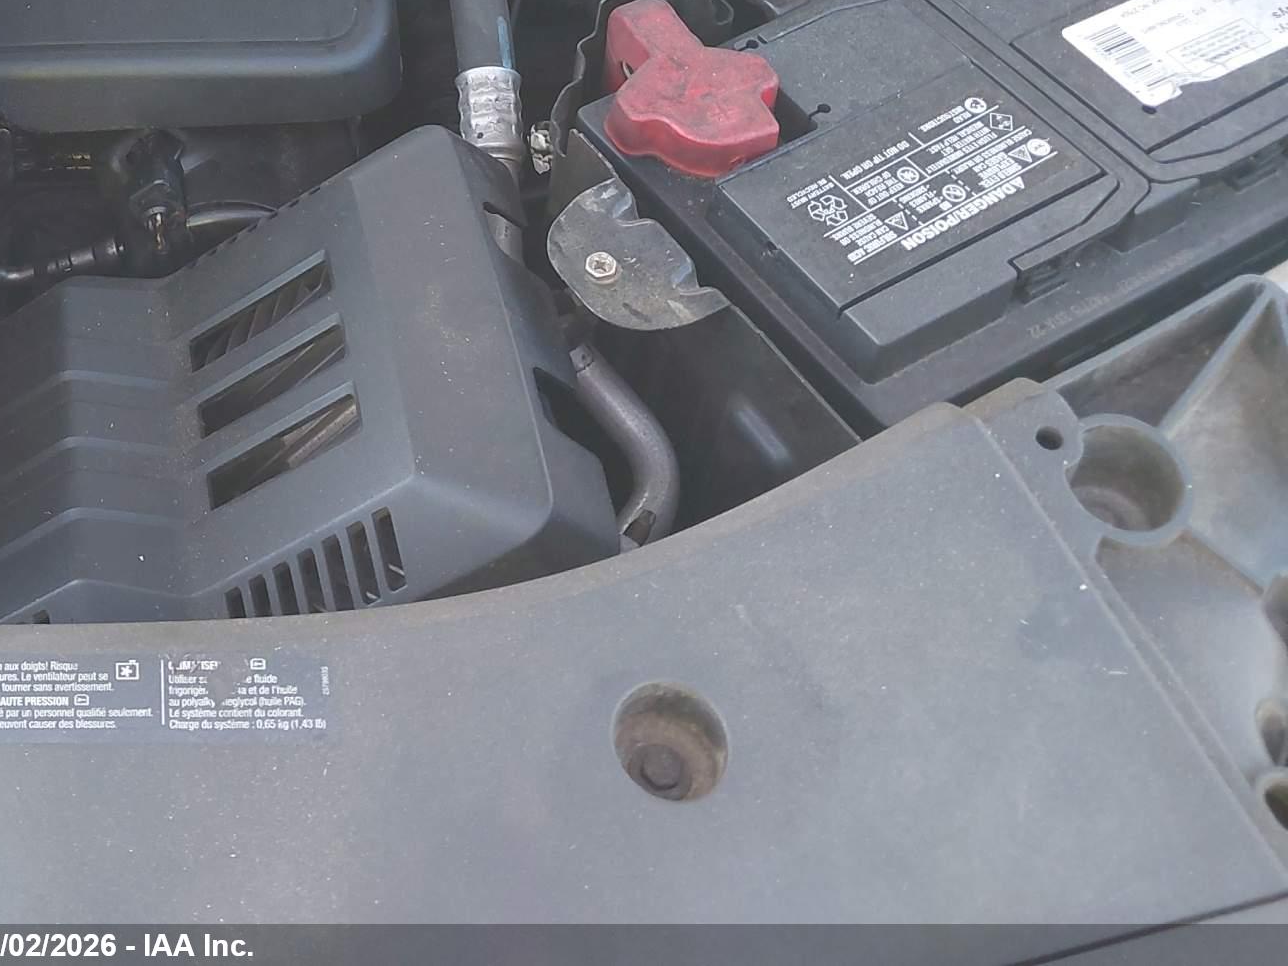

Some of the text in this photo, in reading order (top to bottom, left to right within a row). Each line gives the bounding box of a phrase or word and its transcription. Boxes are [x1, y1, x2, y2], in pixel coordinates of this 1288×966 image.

[898, 182, 1018, 251] DANGER/POISON
[20, 661, 48, 672] doigts!
[20, 672, 31, 681] Le
[33, 672, 76, 681] ventilateur
[77, 672, 96, 683] peut
[1, 682, 31, 691] tourner
[24, 696, 69, 706] PRESSION
[5, 710, 19, 719] par
[33, 708, 74, 719] personnel
[76, 708, 106, 719] qualifié
[58, 719, 74, 728] des
